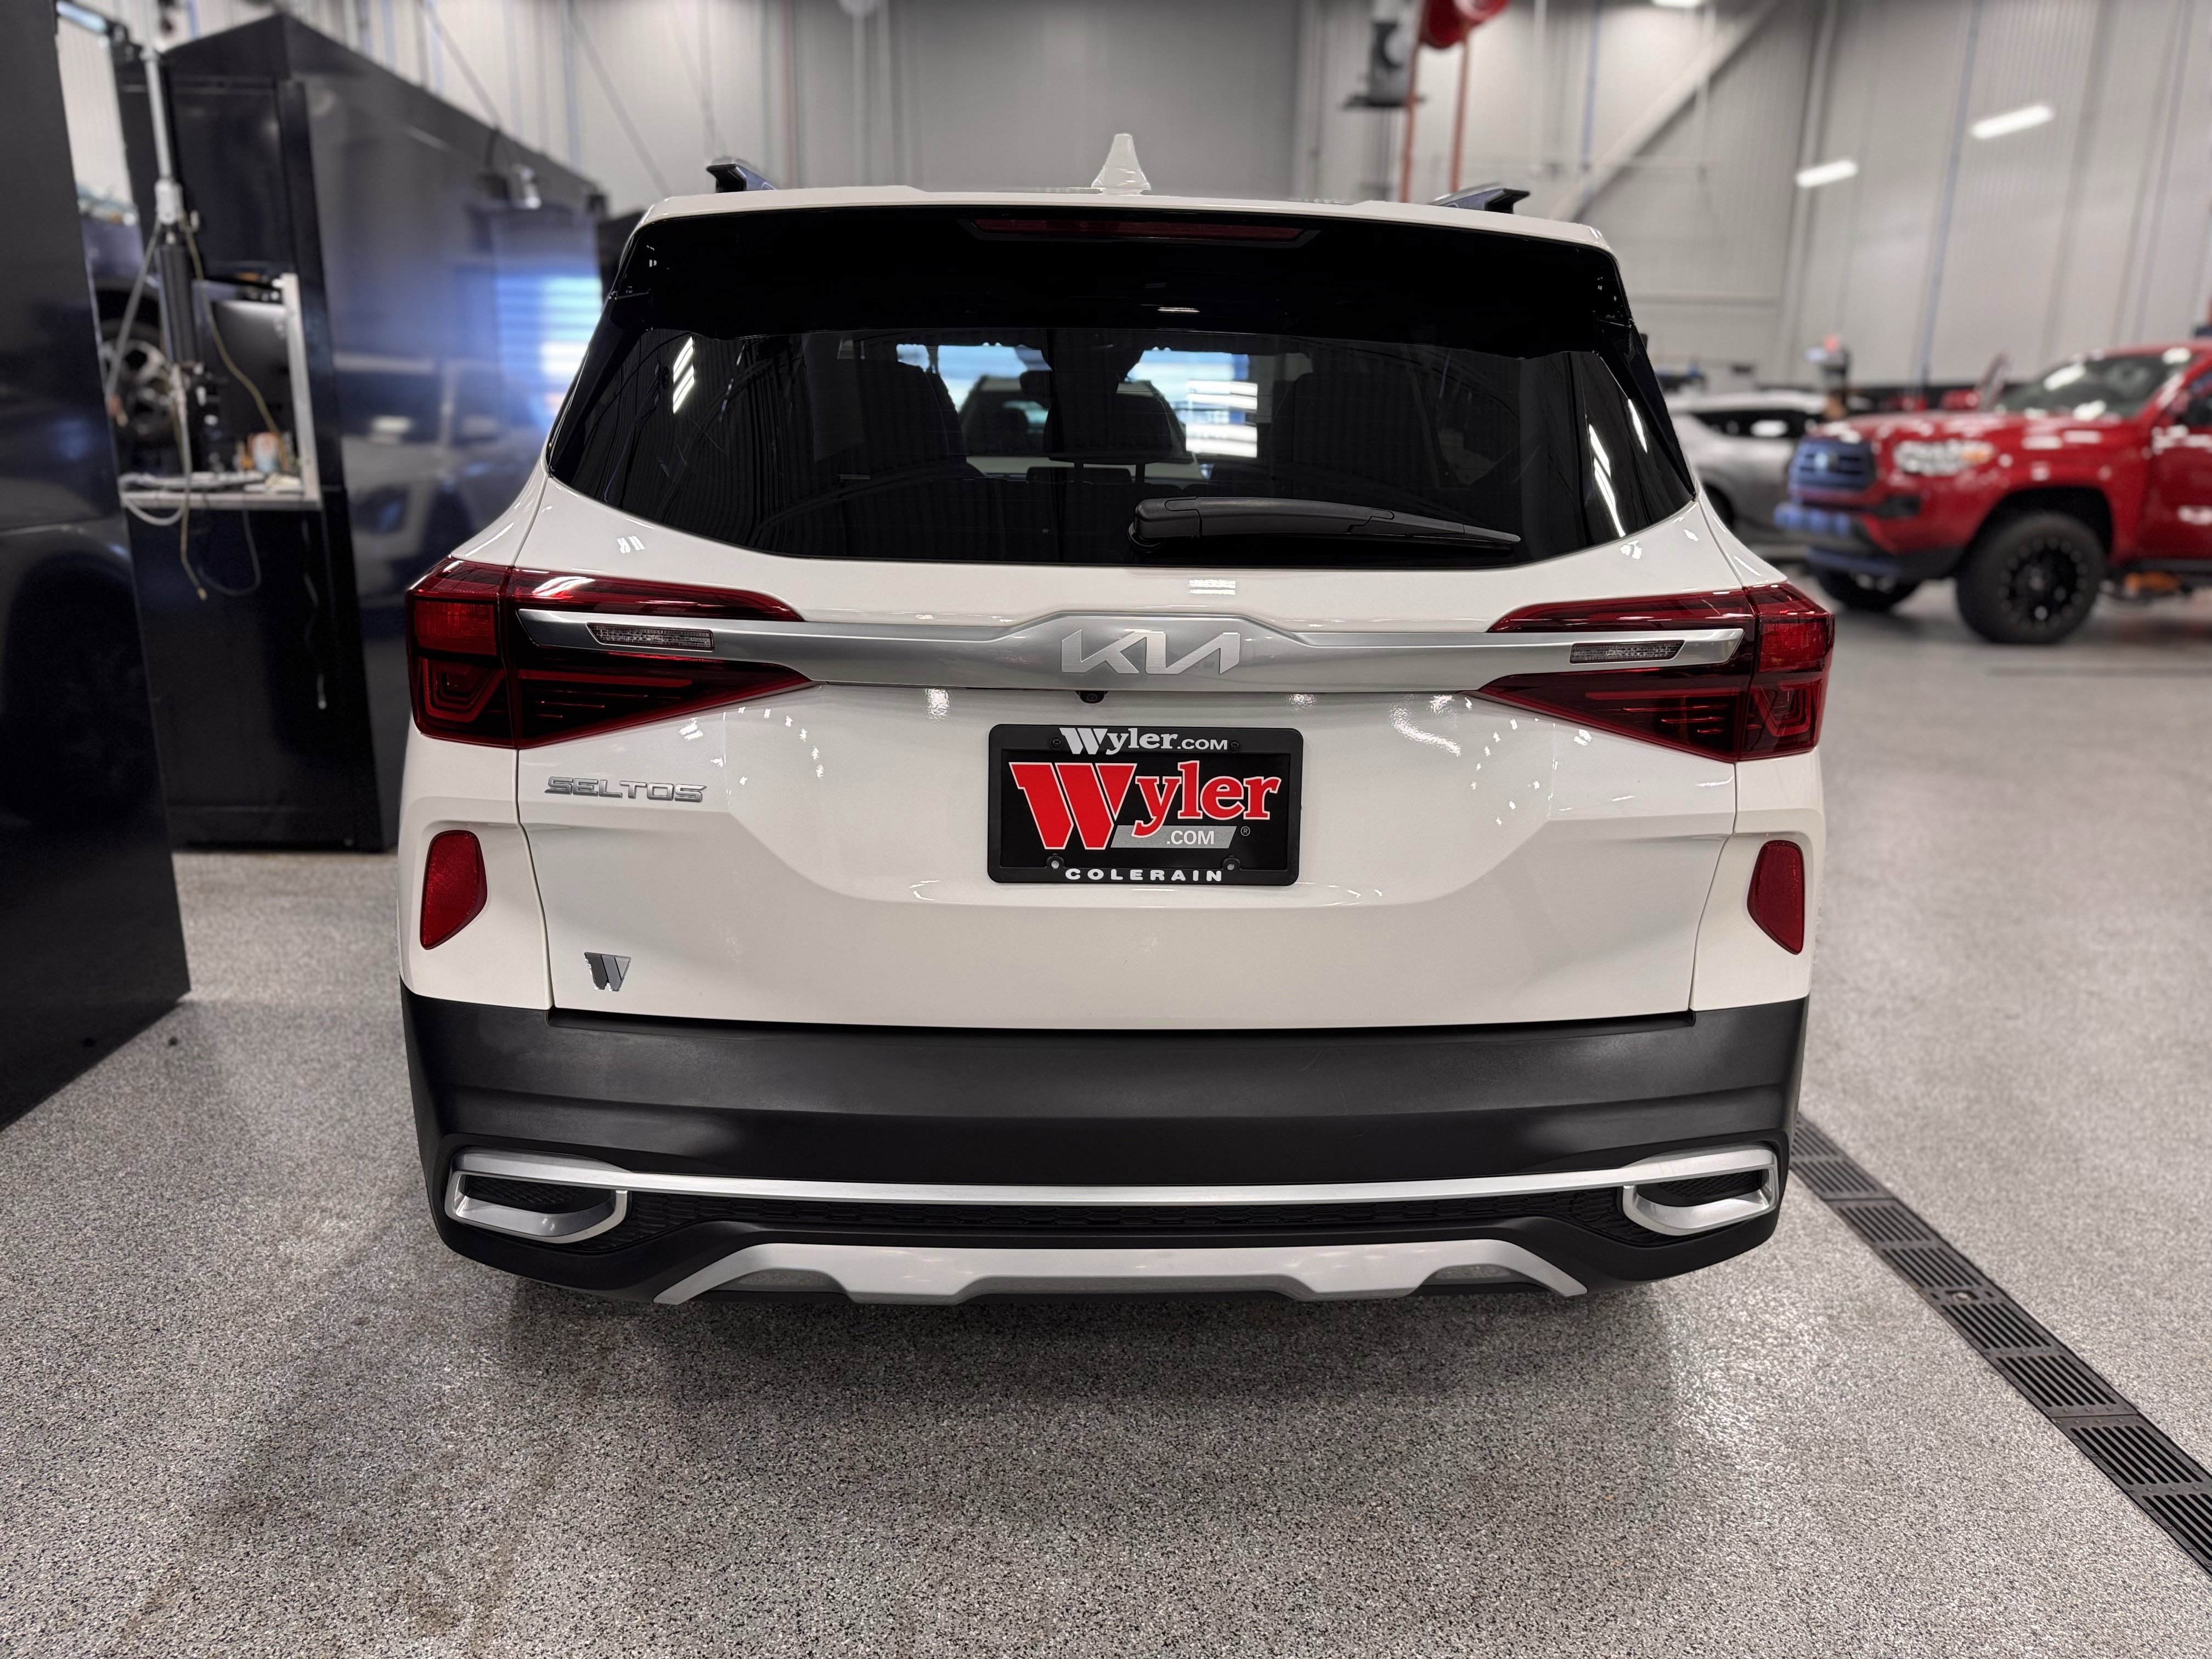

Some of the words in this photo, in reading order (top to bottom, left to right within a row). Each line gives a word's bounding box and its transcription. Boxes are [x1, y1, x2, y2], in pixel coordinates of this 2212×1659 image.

[1060, 629, 1240, 675] KIA
[544, 776, 707, 803] SELTOS
[1008, 760, 1282, 850] Wyler
[1065, 868, 1222, 882] COLERAIN
